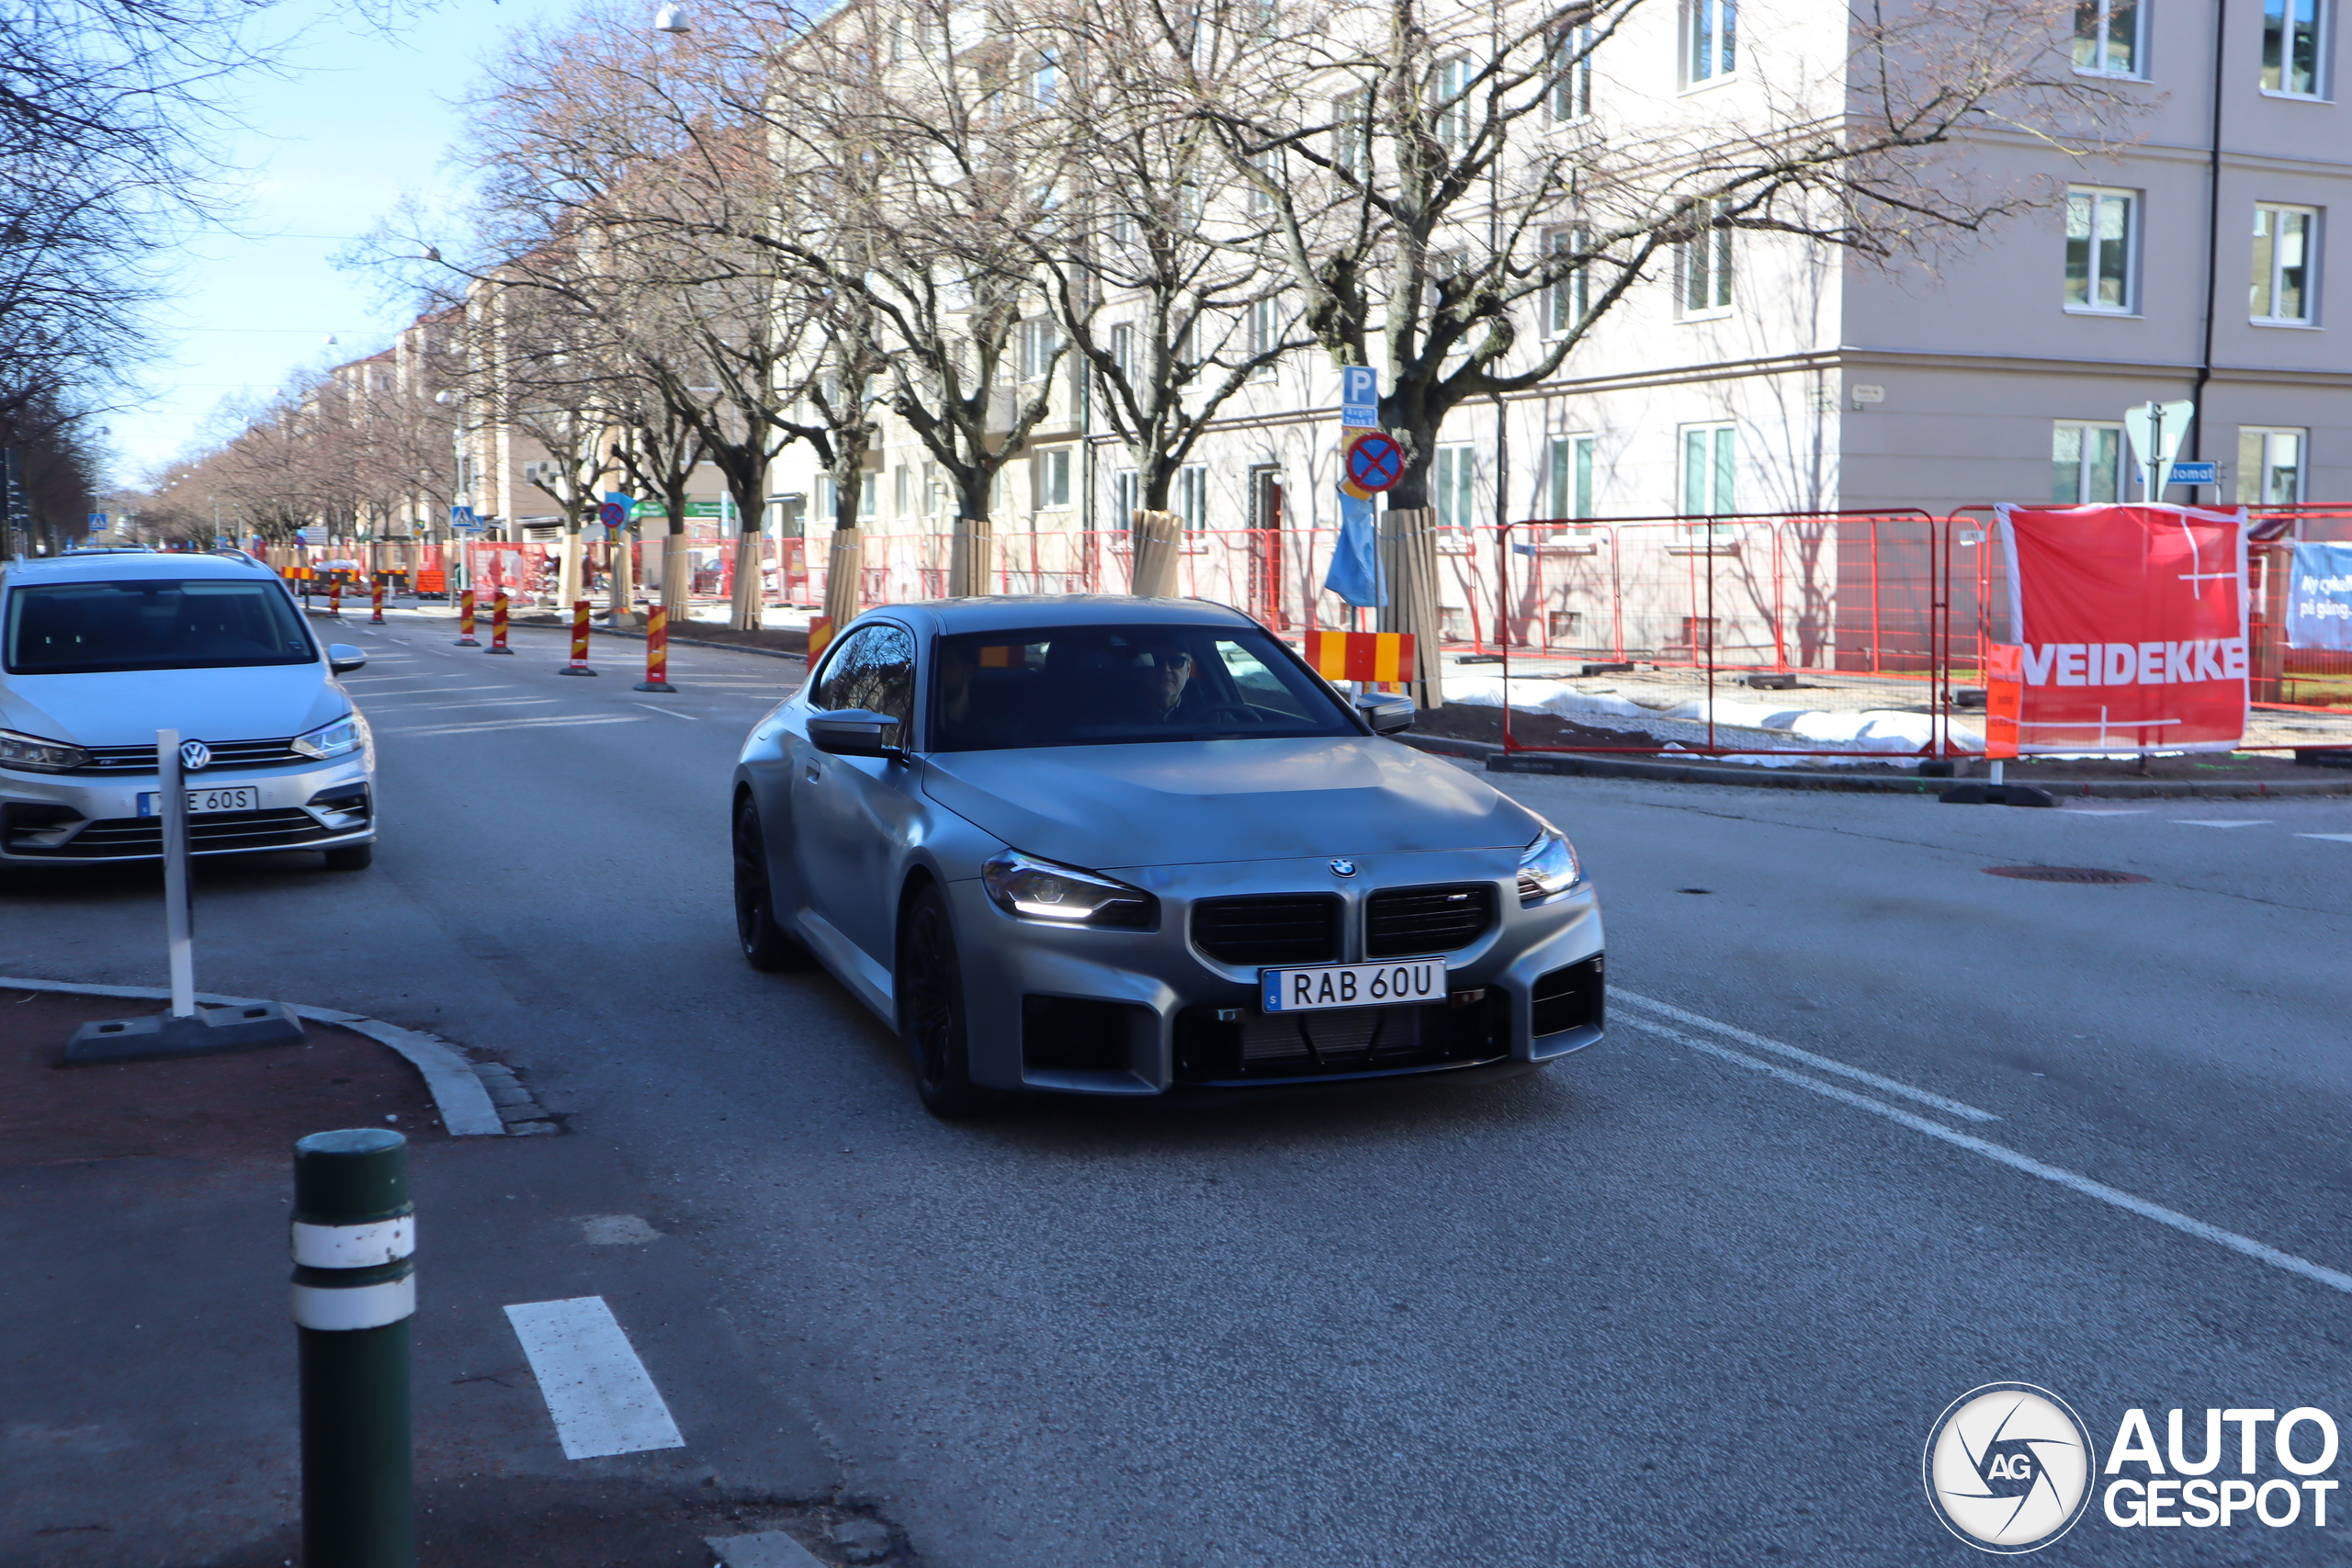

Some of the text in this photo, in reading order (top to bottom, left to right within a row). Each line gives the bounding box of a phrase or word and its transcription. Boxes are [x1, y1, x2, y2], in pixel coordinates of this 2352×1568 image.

[1351, 370, 1372, 401] P
[2301, 575, 2319, 595] Ny
[2300, 598, 2315, 618] på
[2023, 638, 2245, 686] VEIDEKKE
[207, 791, 247, 809] 60S
[1295, 965, 1431, 1005] RAB 60U
[1269, 995, 1276, 1004] S
